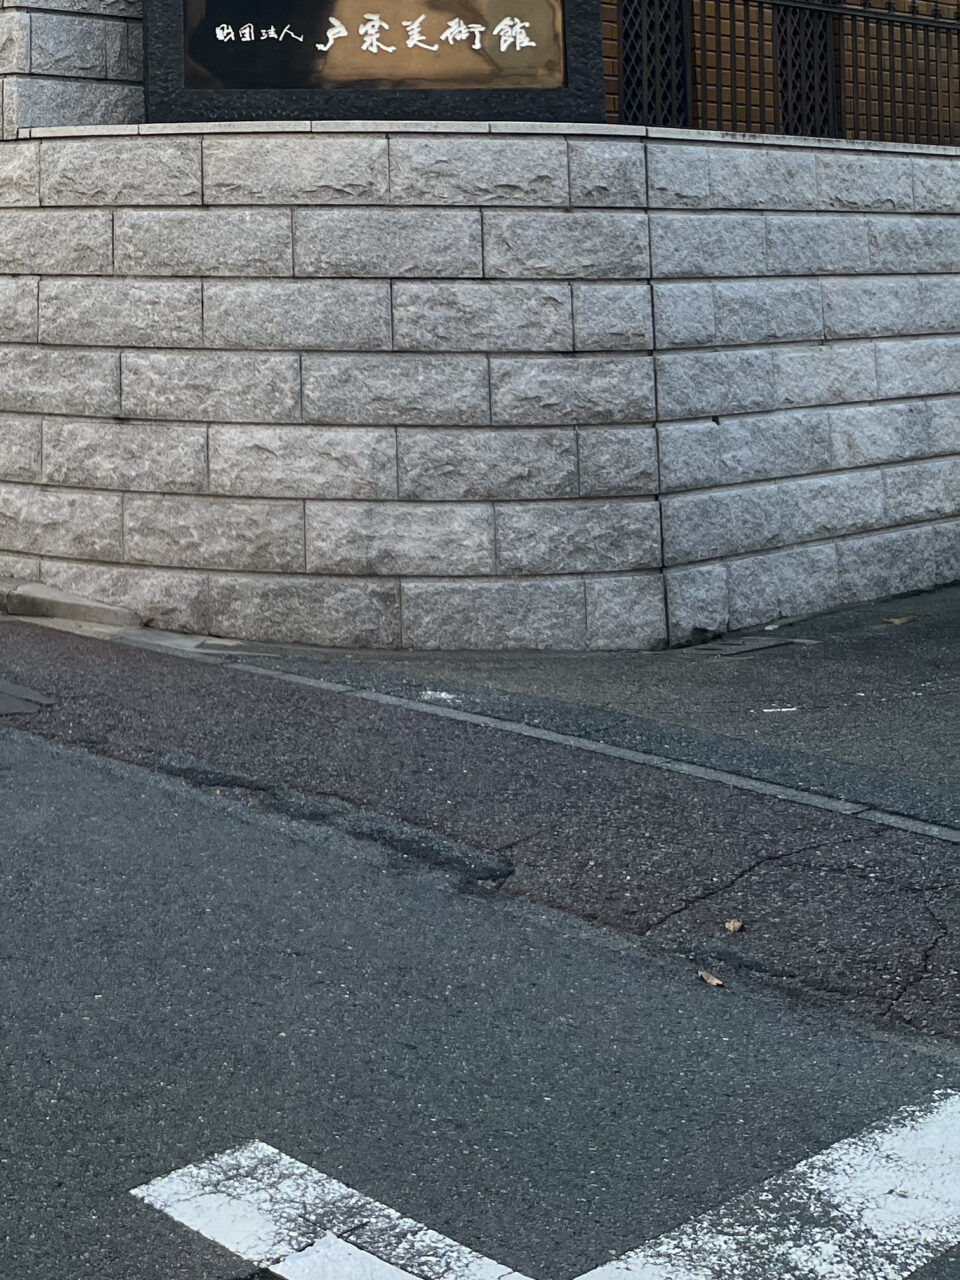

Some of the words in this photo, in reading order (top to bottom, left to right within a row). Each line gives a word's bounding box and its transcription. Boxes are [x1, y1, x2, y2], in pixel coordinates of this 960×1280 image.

[215, 22, 304, 42] 財団法人
[315, 13, 537, 54] 戸栗美術館
